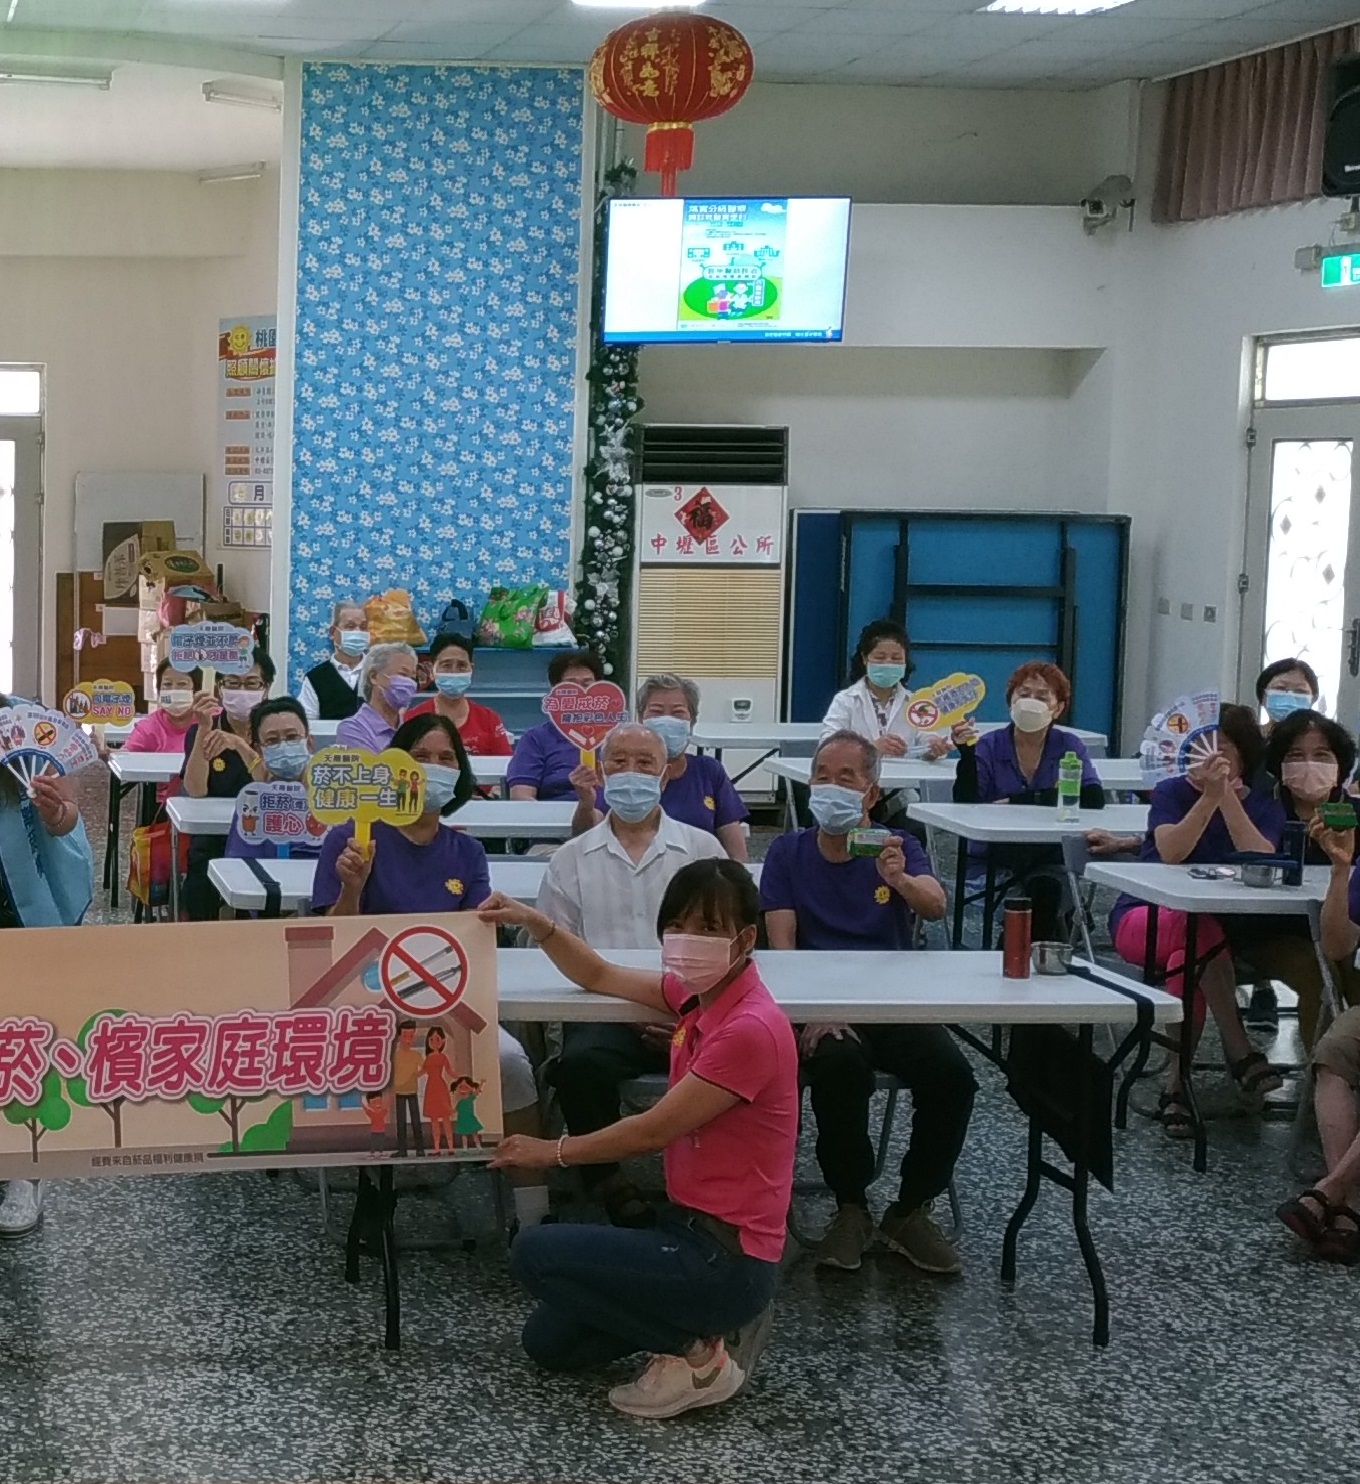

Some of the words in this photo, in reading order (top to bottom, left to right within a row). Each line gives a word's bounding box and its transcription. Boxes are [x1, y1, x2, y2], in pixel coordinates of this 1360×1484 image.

[674, 486, 683, 501] 3
[651, 533, 774, 555] 中壢區公所
[93, 706, 113, 715] SAY
[118, 706, 131, 715] NO
[545, 696, 609, 711] 為愛戒菸
[313, 765, 391, 785] 菸不上身
[315, 788, 397, 808] 健康一生
[265, 812, 303, 834] 護心
